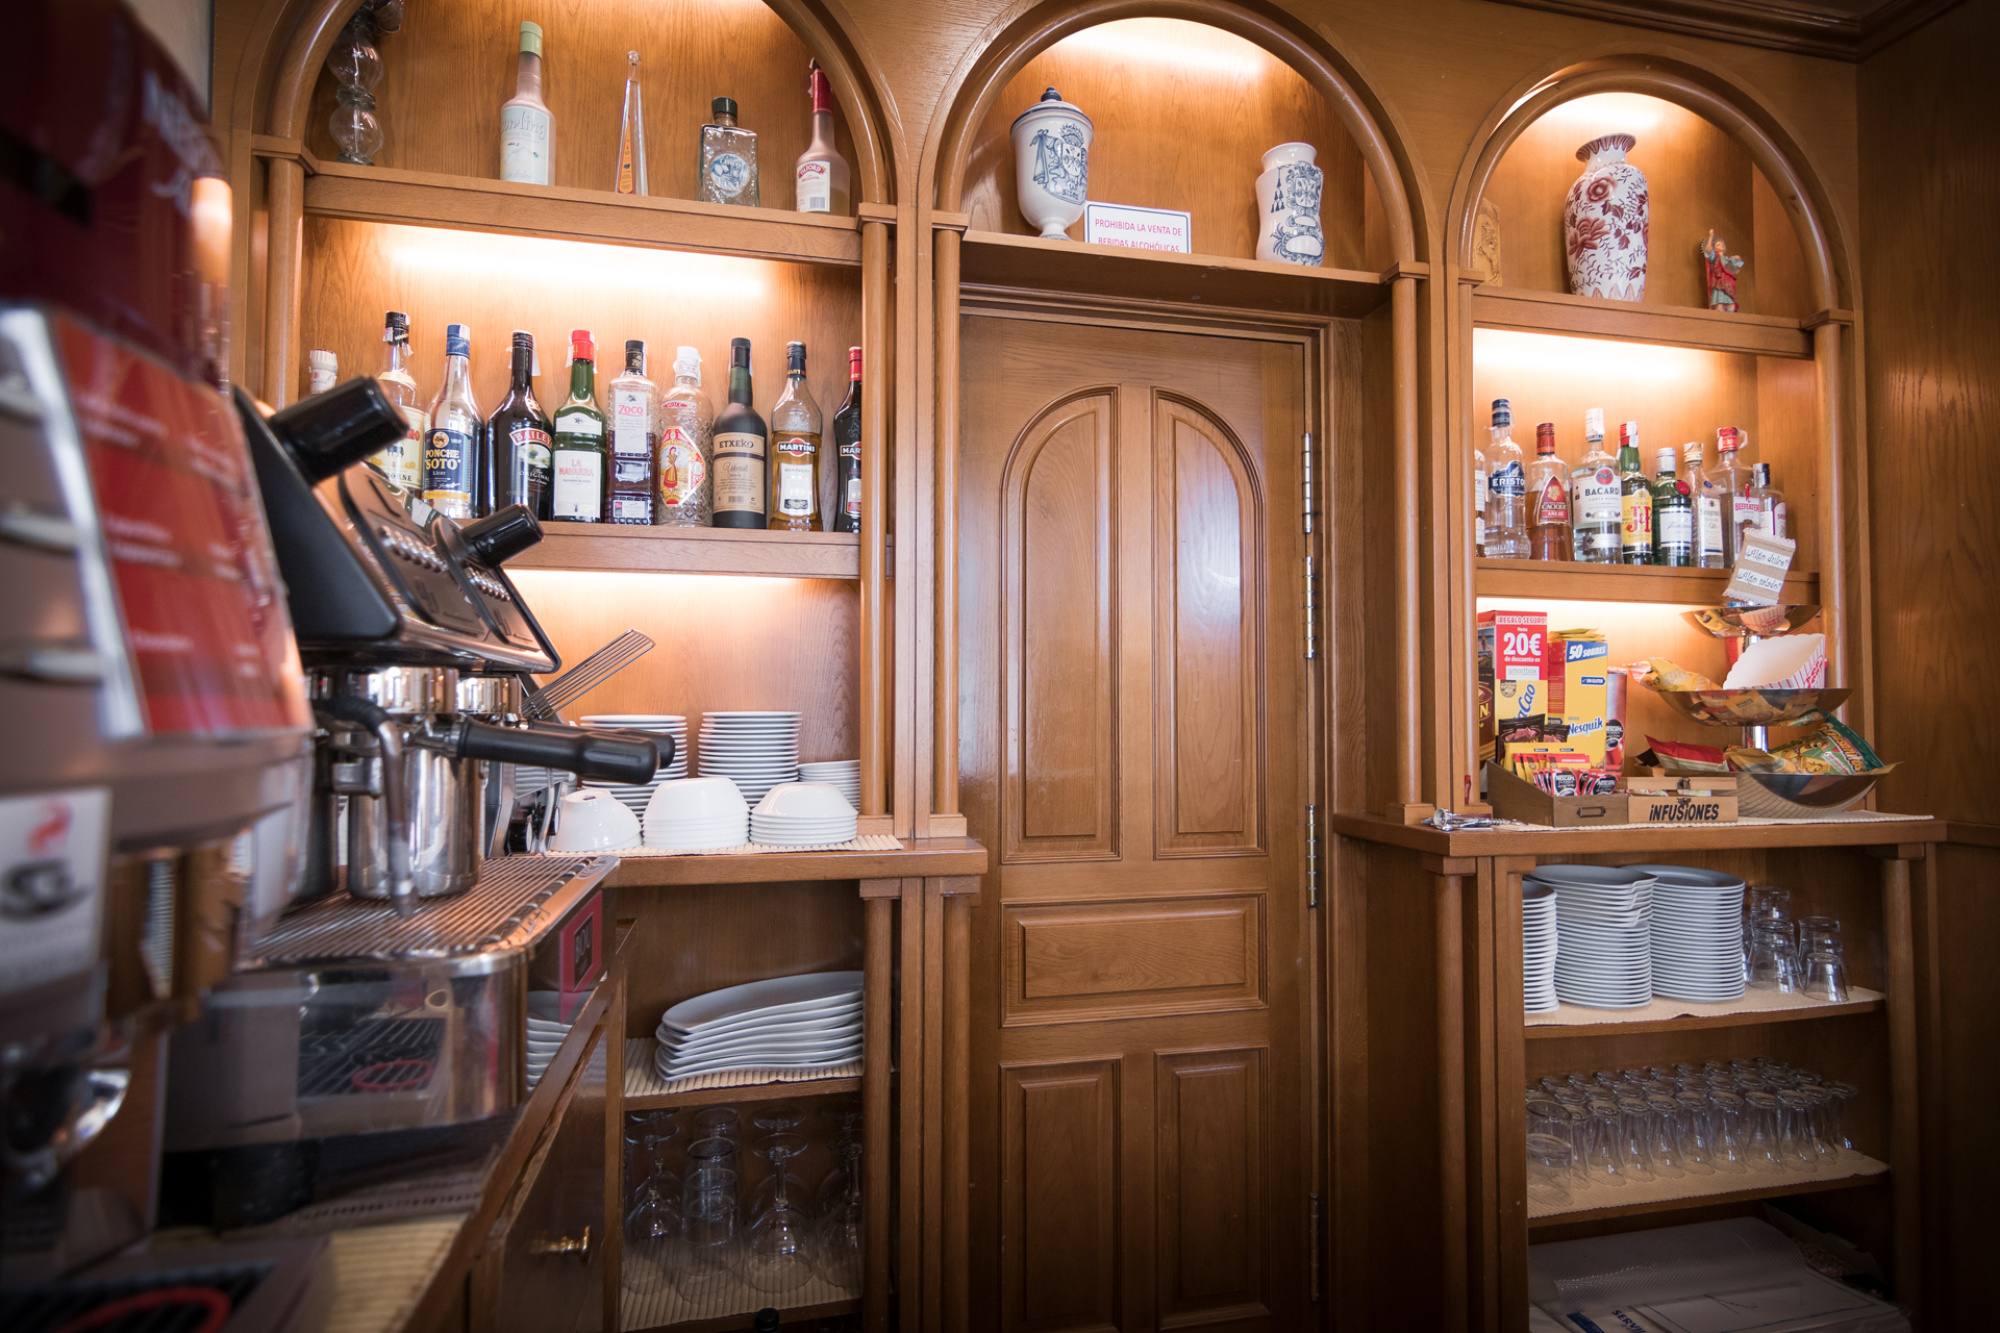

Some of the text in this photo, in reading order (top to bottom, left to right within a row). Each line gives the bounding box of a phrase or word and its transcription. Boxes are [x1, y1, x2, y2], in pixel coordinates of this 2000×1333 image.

[1095, 218, 1182, 236] PROHIBIDA LA VENTA DE
[1098, 237, 1180, 252] BEBIDAS ALCOHÓLICAS
[618, 404, 644, 414] ZOCO
[779, 443, 816, 452] MARTINI
[425, 449, 460, 459] PONCHE
[571, 459, 581, 467] LA
[559, 467, 594, 477] NAVARRA
[1734, 502, 1760, 512] BEEFEATER
[1767, 554, 1788, 567] dulce?
[1503, 632, 1542, 656] 20€
[1568, 644, 1606, 660] 50 SOBRES
[1568, 718, 1603, 734] Nesquik
